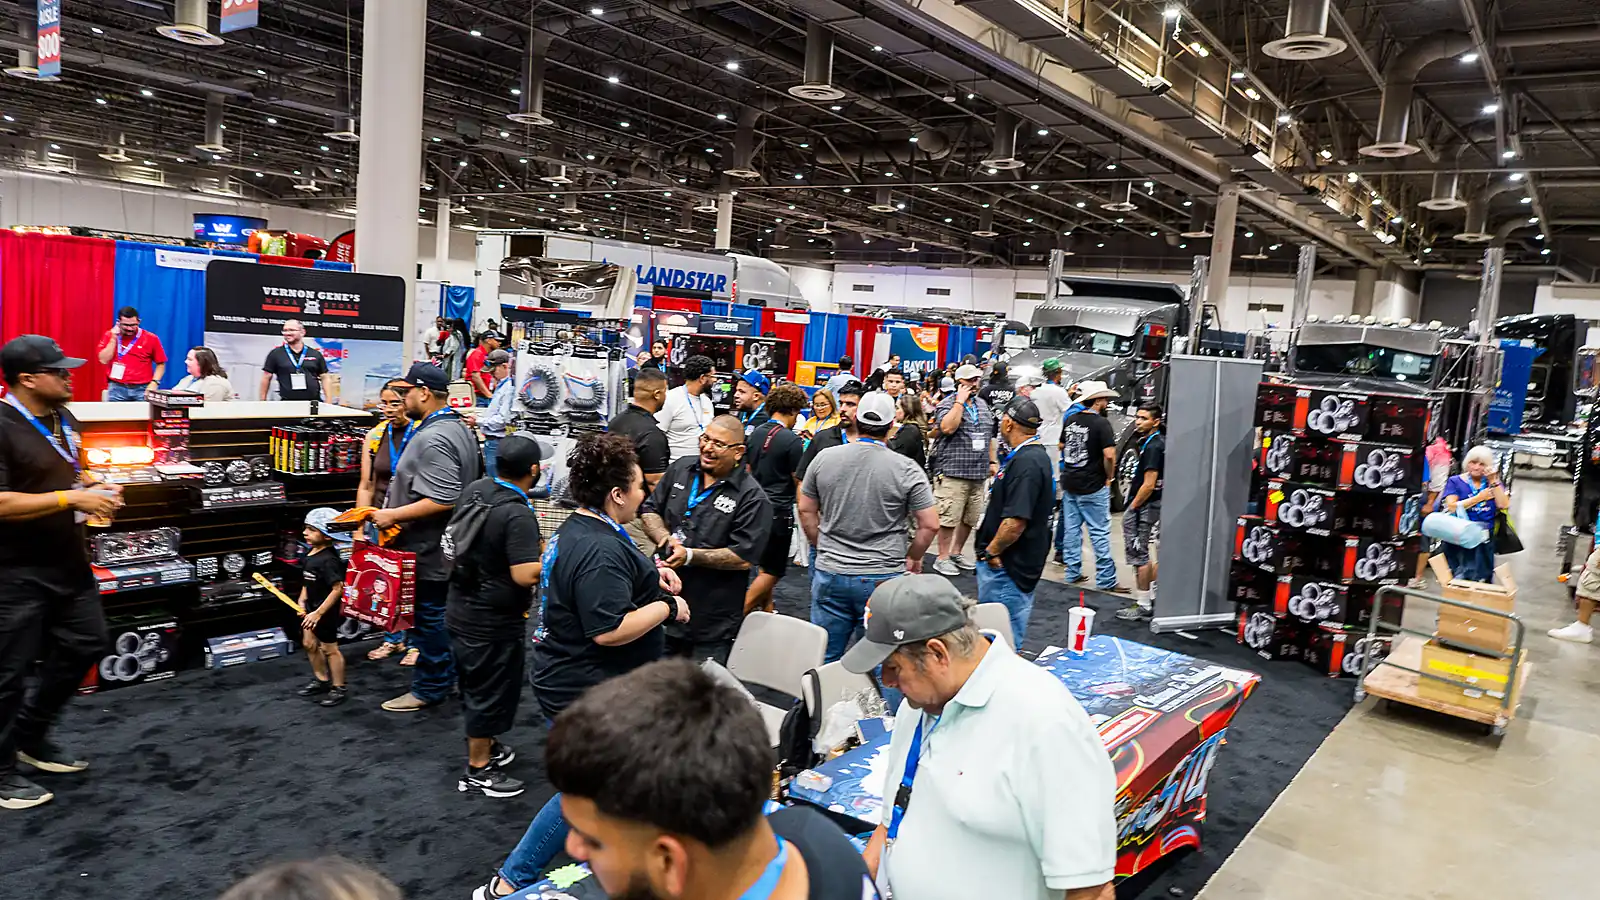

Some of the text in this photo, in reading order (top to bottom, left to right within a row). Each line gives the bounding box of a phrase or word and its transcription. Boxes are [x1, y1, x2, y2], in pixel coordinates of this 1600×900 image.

[39, 6, 59, 26] AISLE
[39, 31, 60, 60] 800
[636, 263, 727, 293] LANDSTAR
[262, 286, 361, 302] VERNON GENE'S
[265, 297, 360, 310] MEGA STORE
[903, 359, 935, 374] BAYOU
